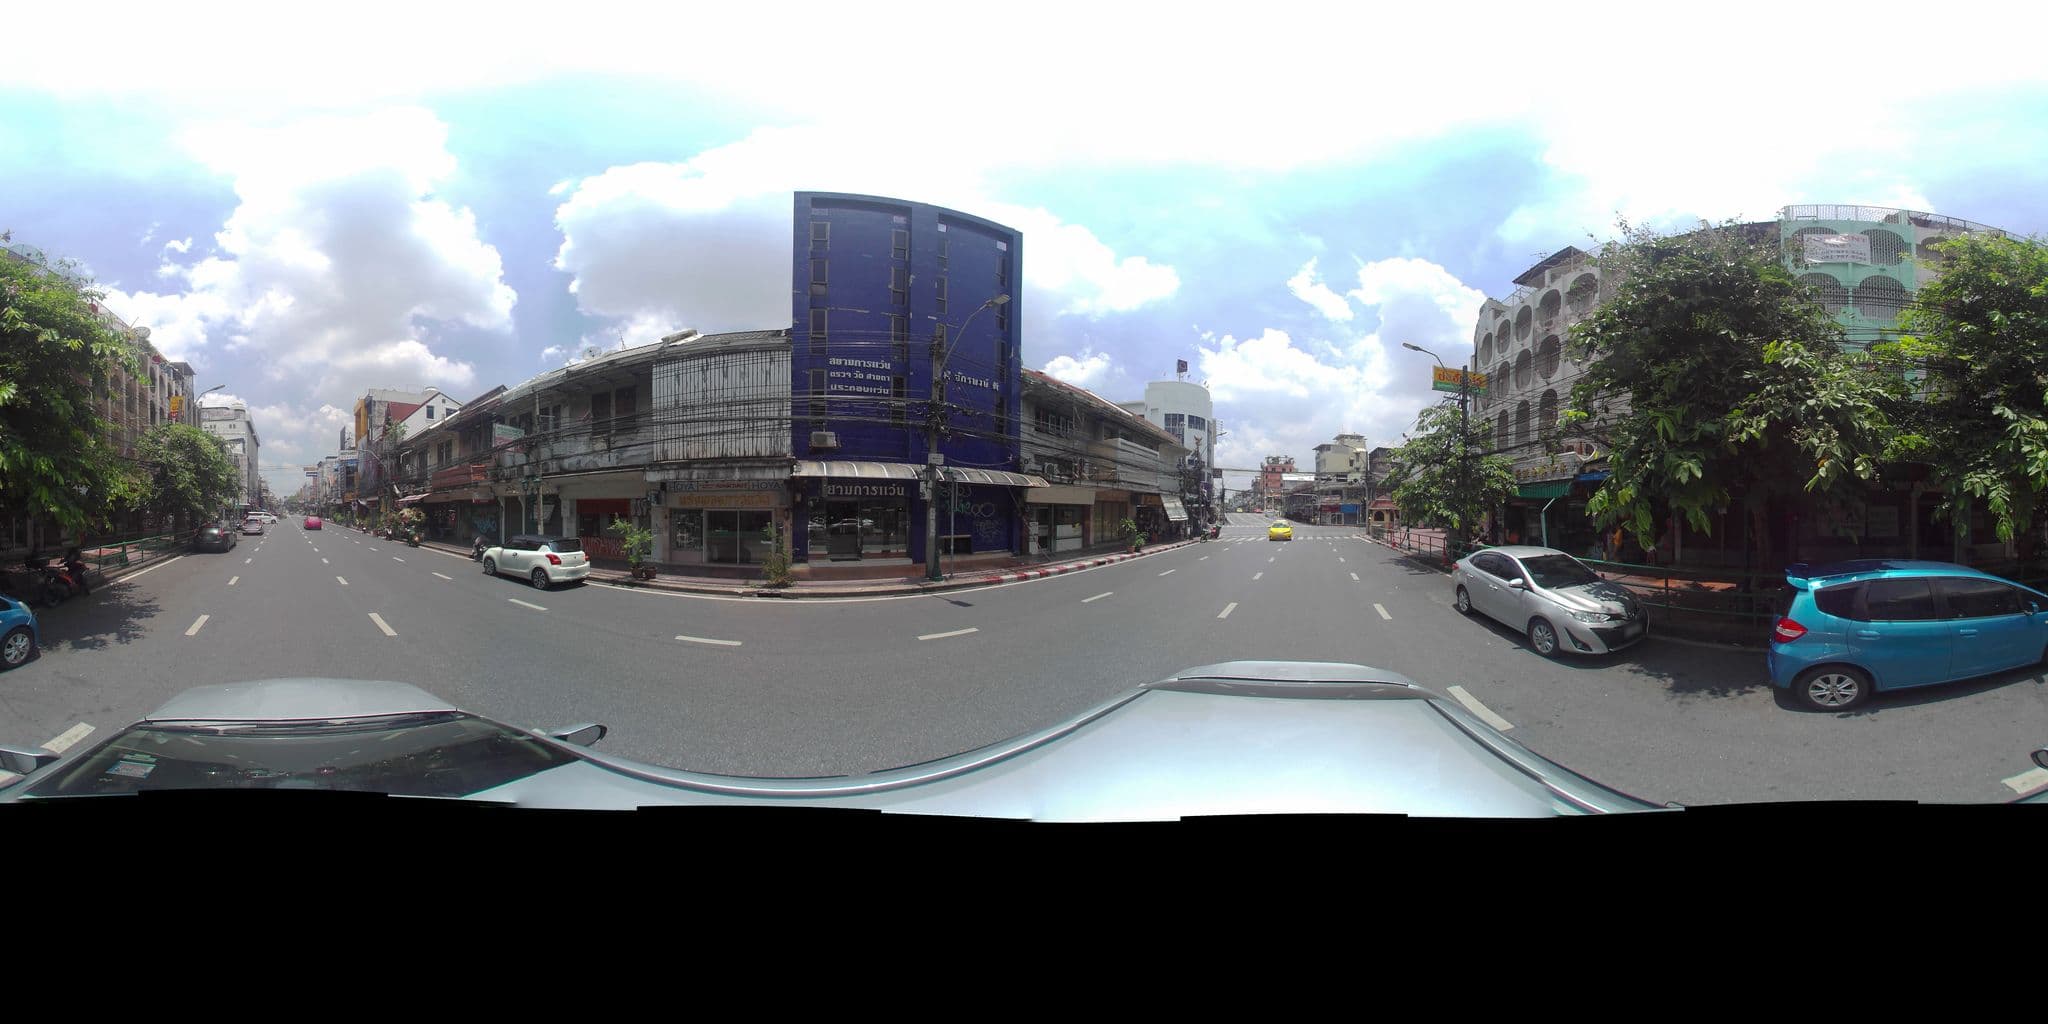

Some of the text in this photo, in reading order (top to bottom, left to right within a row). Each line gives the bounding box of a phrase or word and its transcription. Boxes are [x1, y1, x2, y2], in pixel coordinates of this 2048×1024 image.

[829, 357, 891, 370] สยามการแว่น
[830, 383, 889, 394] ประกอบแว่น
